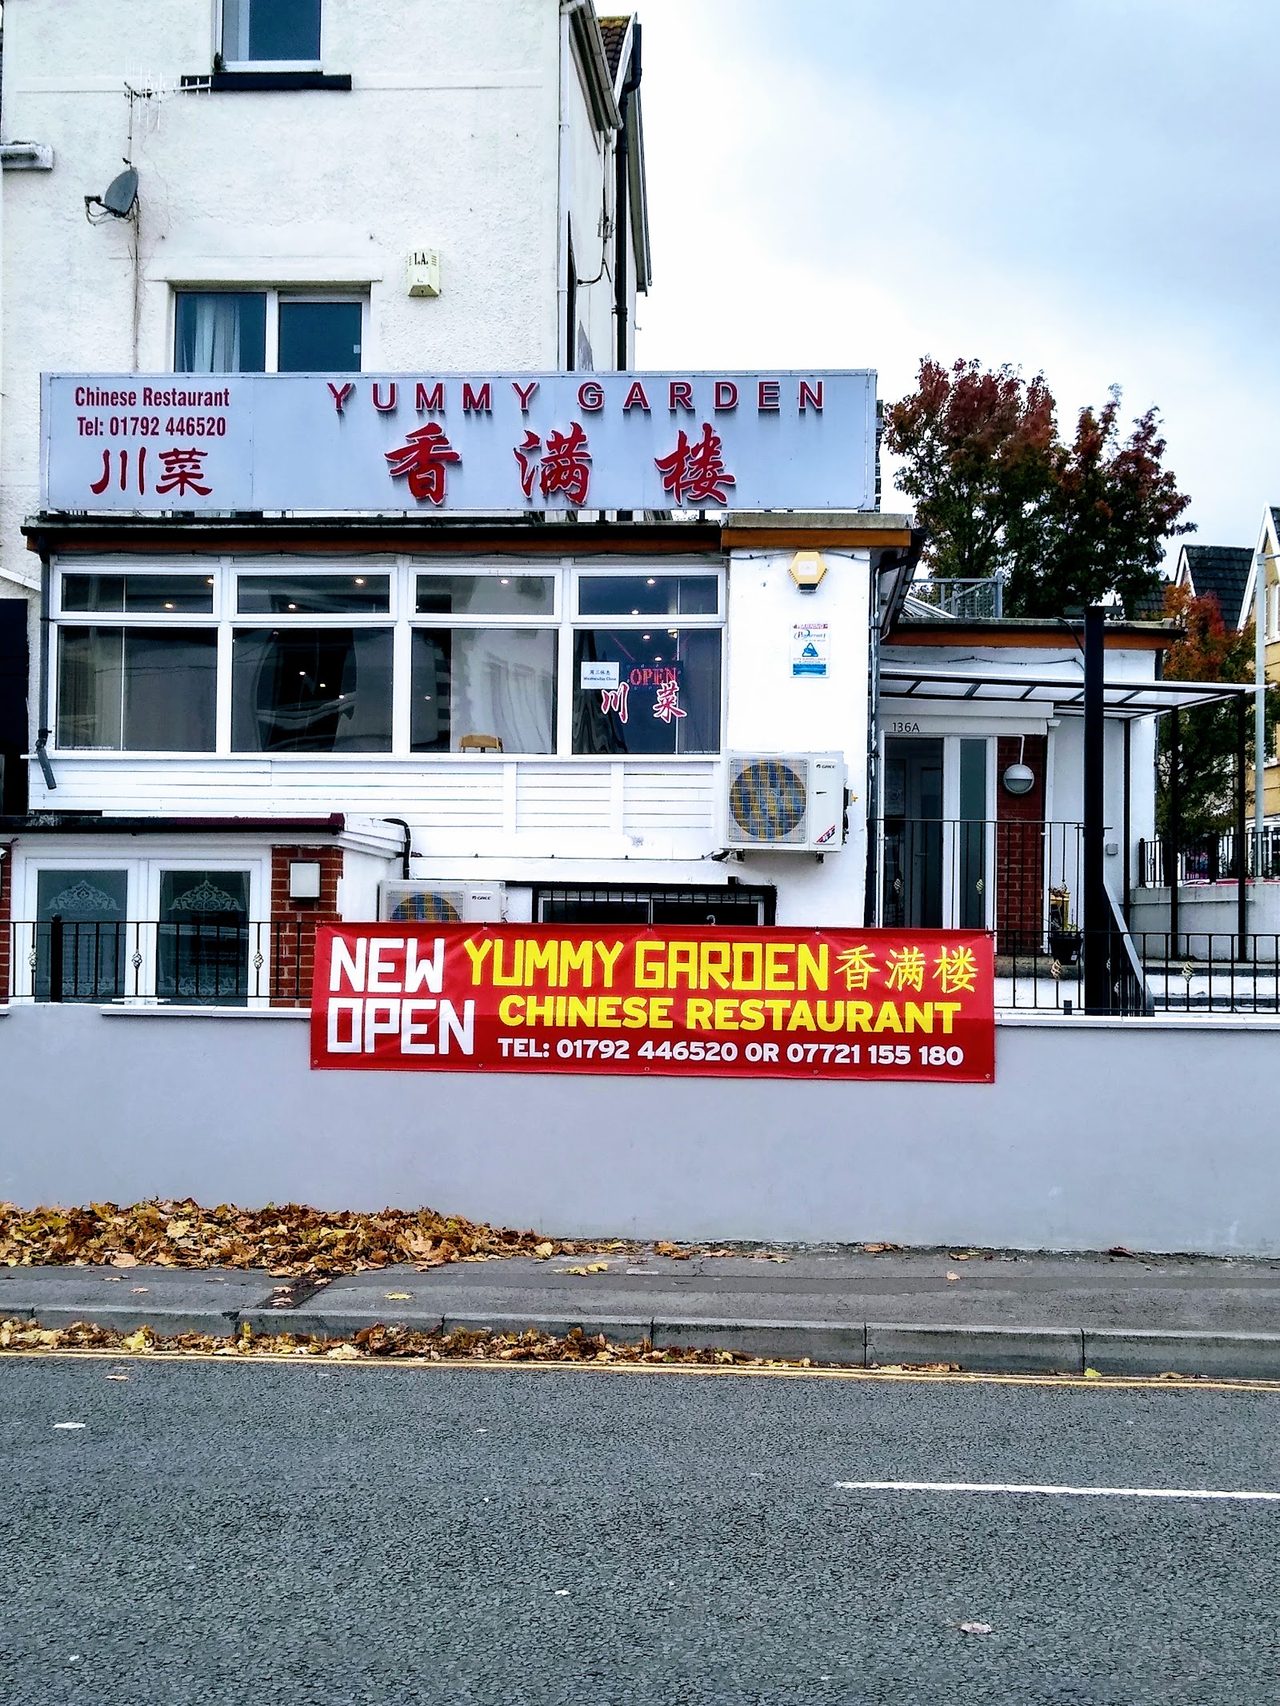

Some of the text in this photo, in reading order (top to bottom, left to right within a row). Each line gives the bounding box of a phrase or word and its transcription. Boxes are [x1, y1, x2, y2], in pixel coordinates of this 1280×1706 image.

[74, 386, 230, 407] Chinese Restaurant
[327, 380, 825, 411] YUMMY GARDEN
[77, 416, 226, 437] Tel: 01792 446520
[90, 446, 213, 497] 川菜
[384, 421, 737, 507] 香满楼
[629, 667, 678, 686] OPEN
[601, 681, 688, 724] 川菜
[892, 722, 920, 733] 136A
[329, 937, 446, 993] NEW
[463, 938, 829, 992] YUMMY GARDEN
[834, 944, 979, 994] 香满楼
[327, 997, 476, 1055] OPEN
[498, 994, 962, 1034] CHINESE RESTAURANT
[497, 1037, 965, 1066] TEL: 01792 446520 OR 07721 155 180
